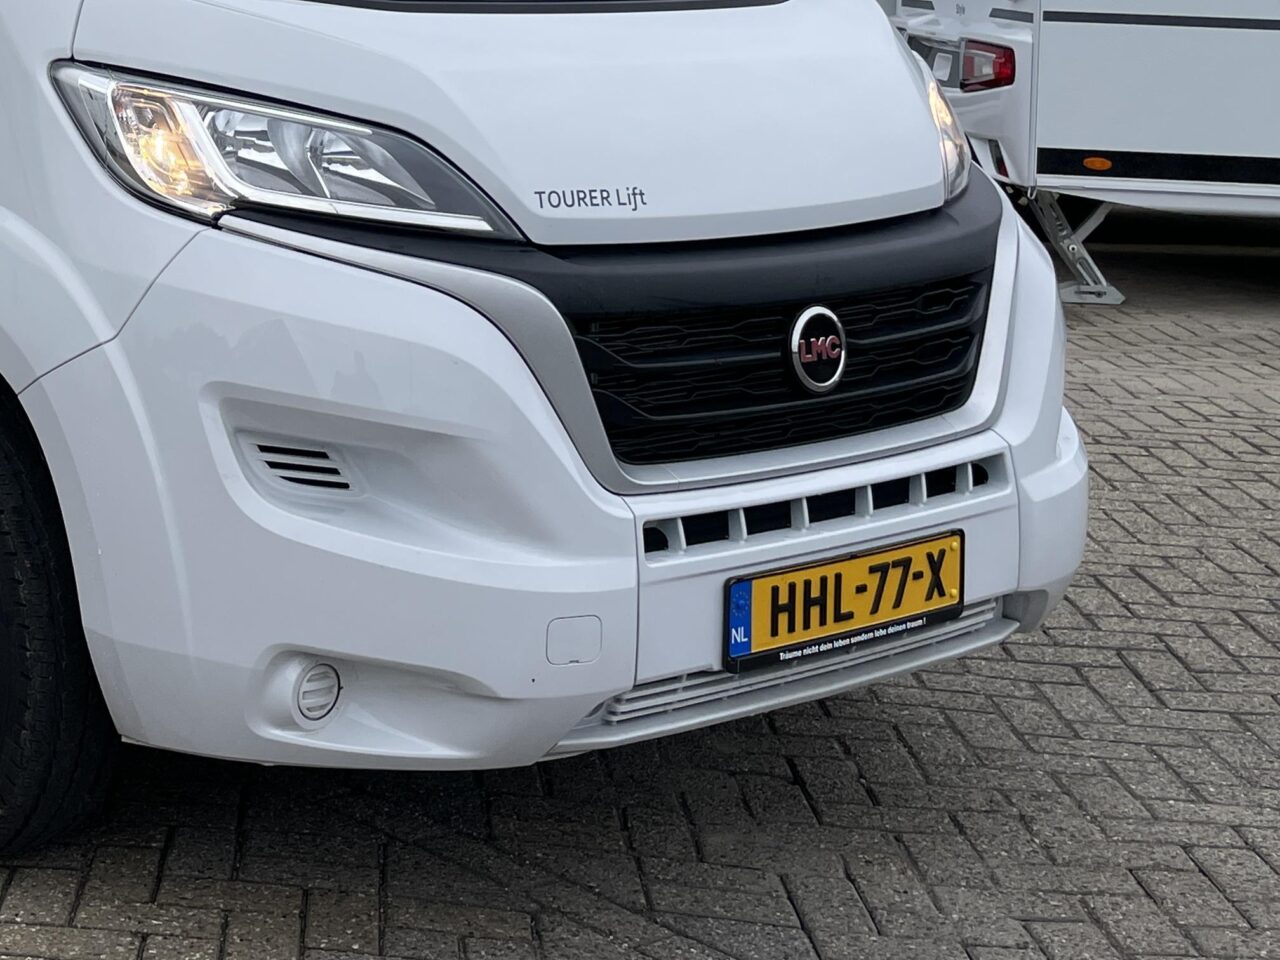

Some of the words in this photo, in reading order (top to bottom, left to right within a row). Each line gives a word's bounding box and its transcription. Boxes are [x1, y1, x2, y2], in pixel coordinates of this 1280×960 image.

[534, 189, 612, 208] TOURER
[616, 187, 647, 211] Lift
[799, 335, 841, 363] LMC
[770, 548, 947, 638] HHL-77-X
[731, 627, 749, 644] NL
